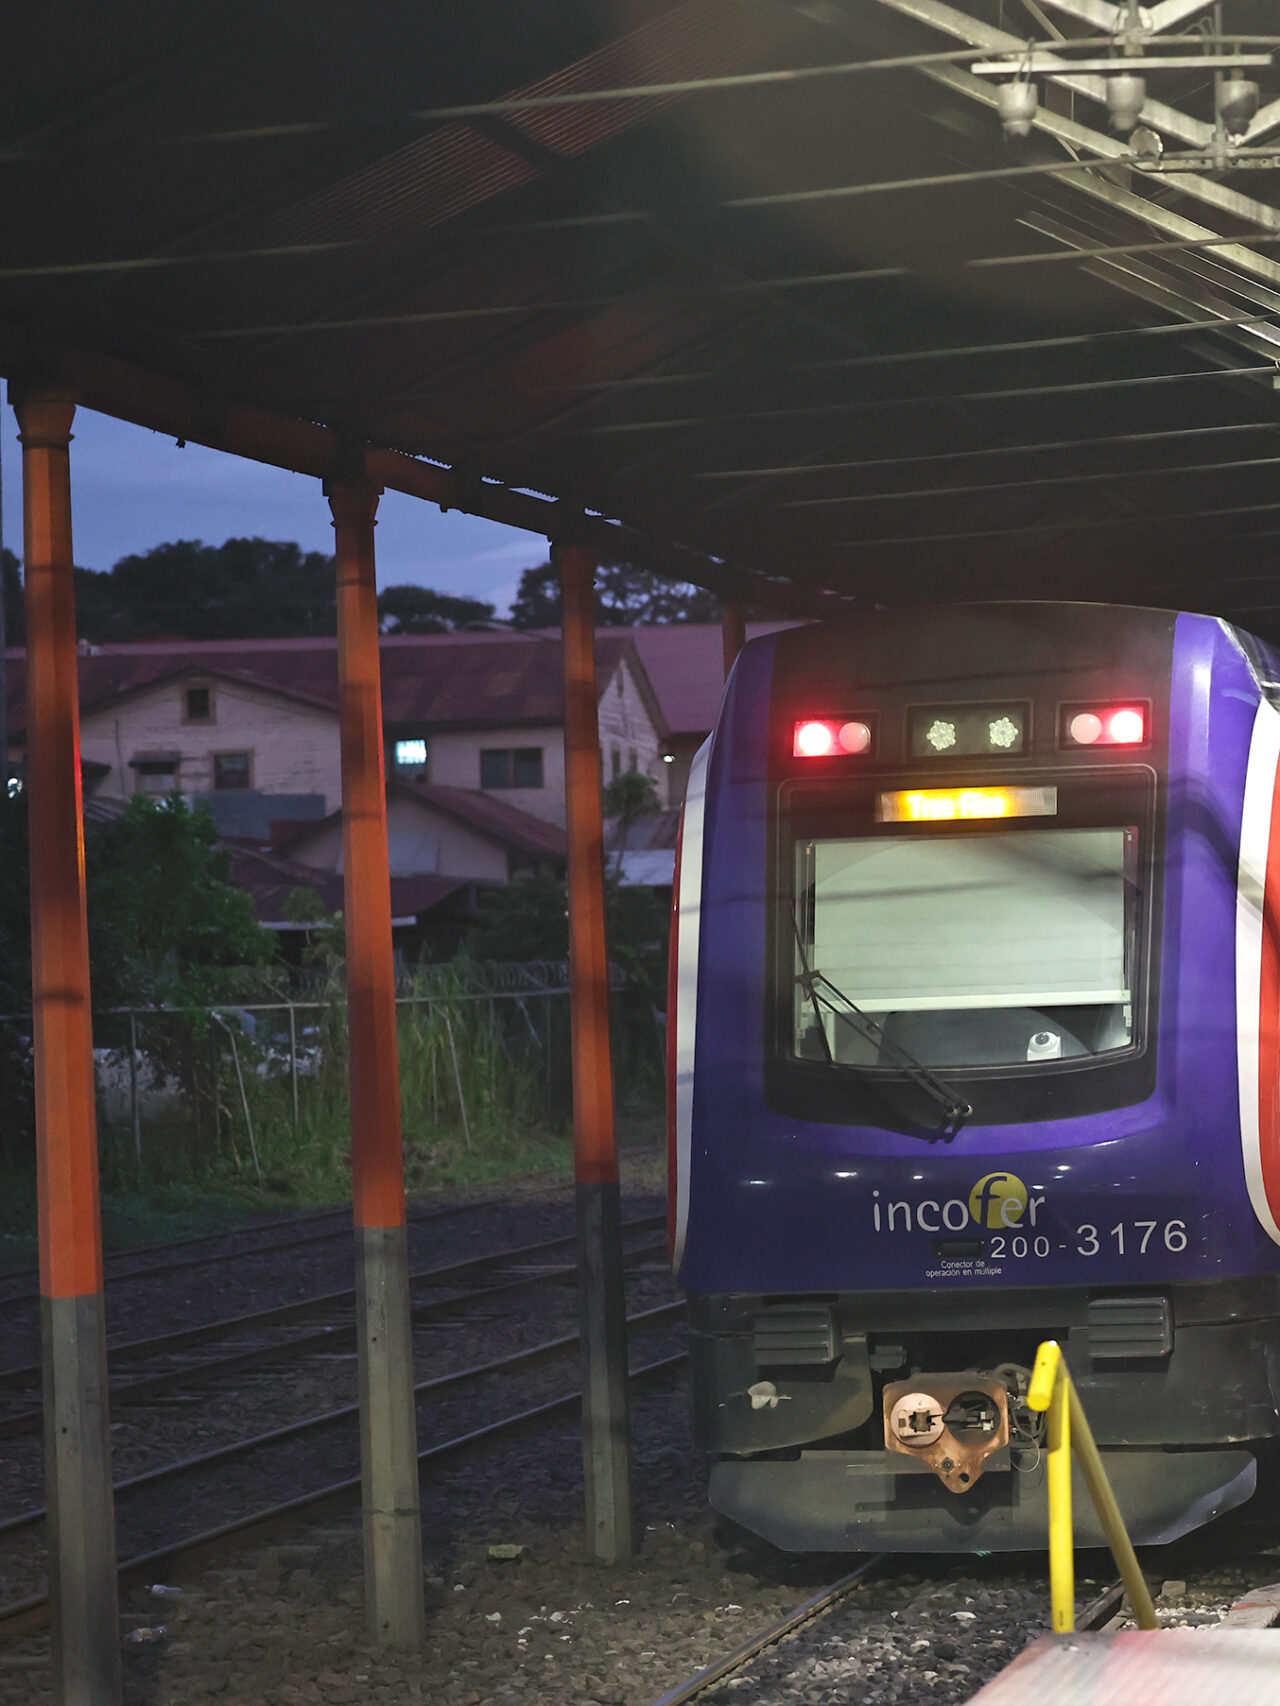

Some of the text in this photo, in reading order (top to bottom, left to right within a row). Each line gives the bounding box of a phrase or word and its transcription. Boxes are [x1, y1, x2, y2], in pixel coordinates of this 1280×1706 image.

[872, 1174, 1046, 1233] incofer
[940, 1260, 985, 1269] Conector de
